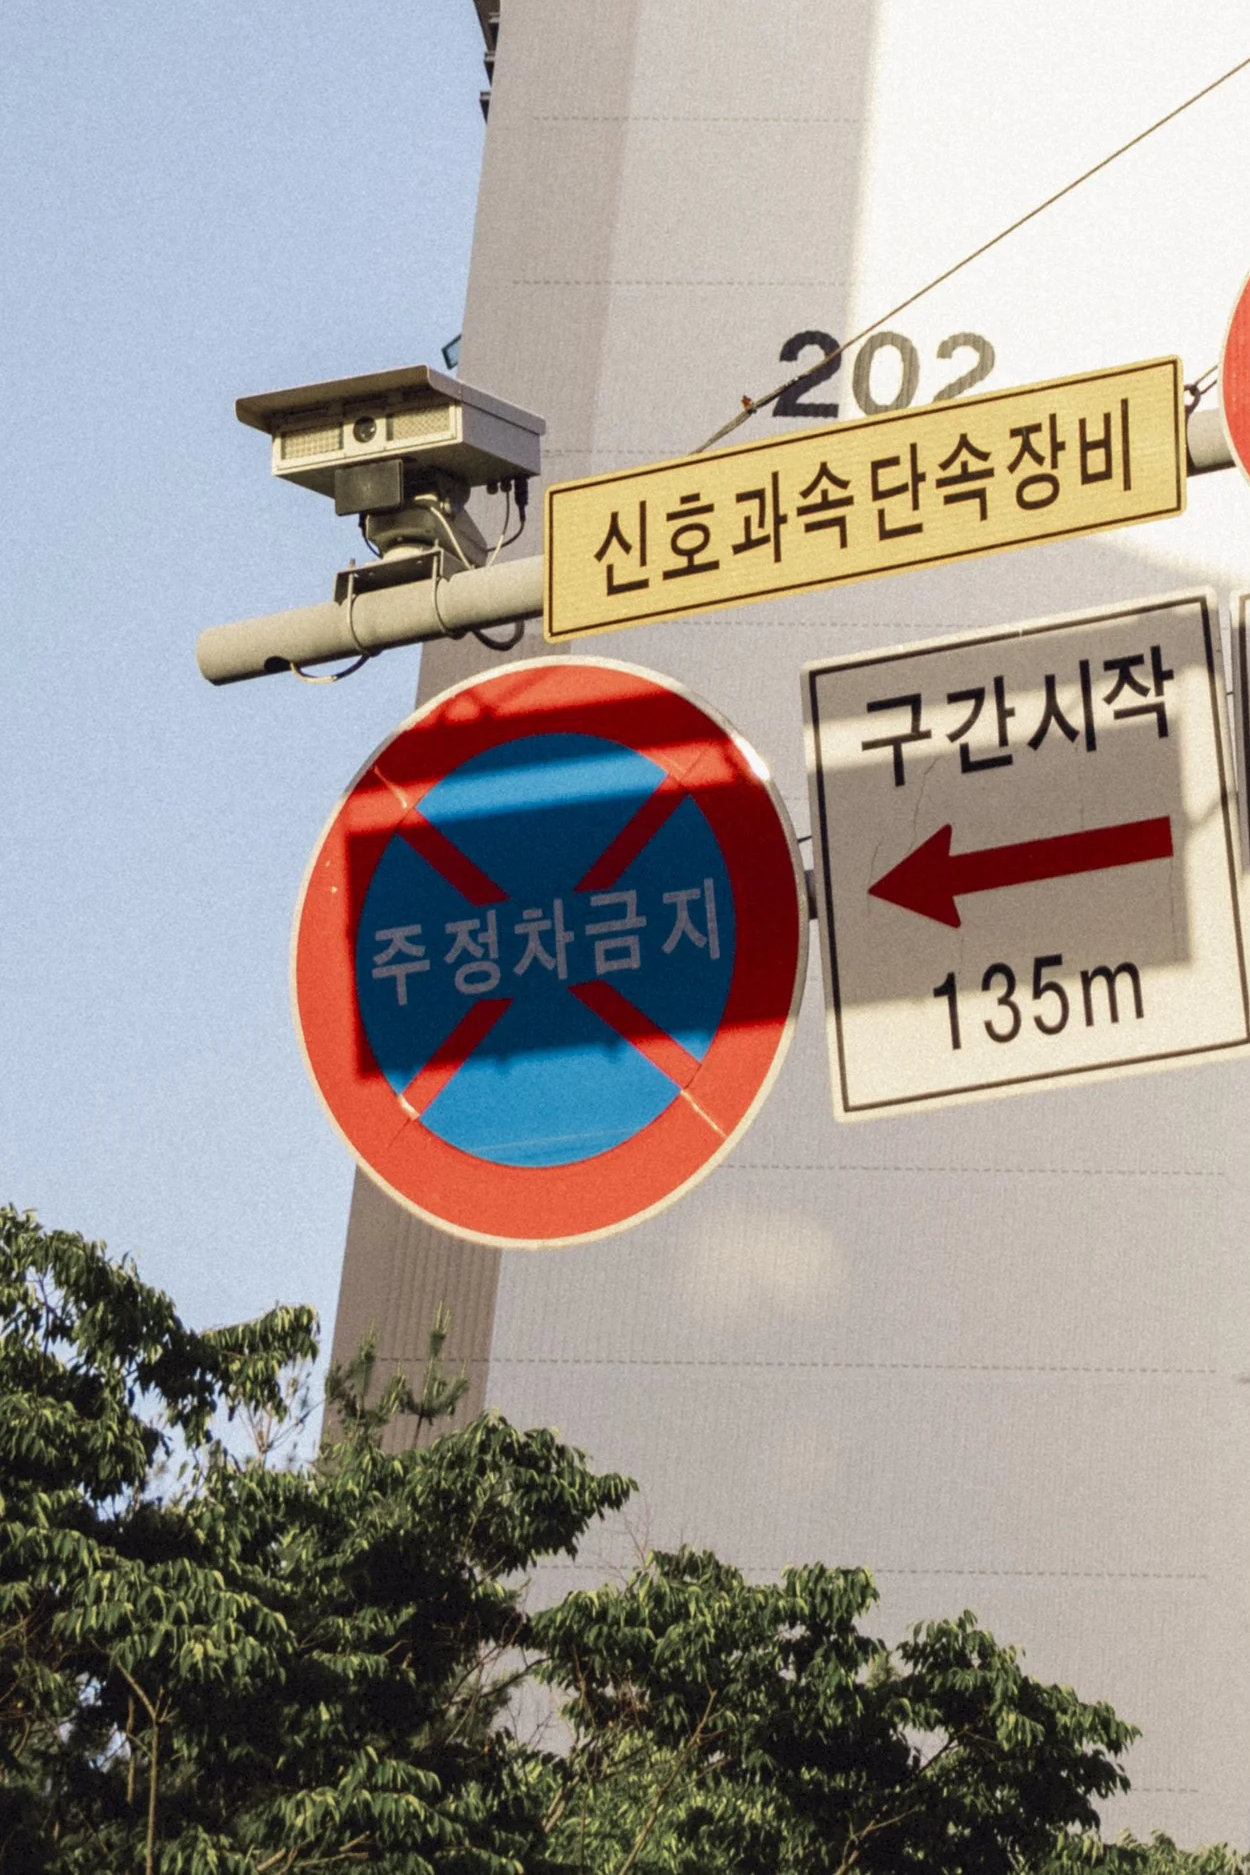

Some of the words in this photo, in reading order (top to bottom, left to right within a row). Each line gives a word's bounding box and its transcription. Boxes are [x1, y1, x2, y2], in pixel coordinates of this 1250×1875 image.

[771, 329, 997, 418] 202
[593, 397, 1133, 597] 신호과속단속장비
[861, 644, 1175, 788] 구간시작
[371, 877, 722, 1006] 주정차금지
[932, 952, 1145, 1051] 135m
